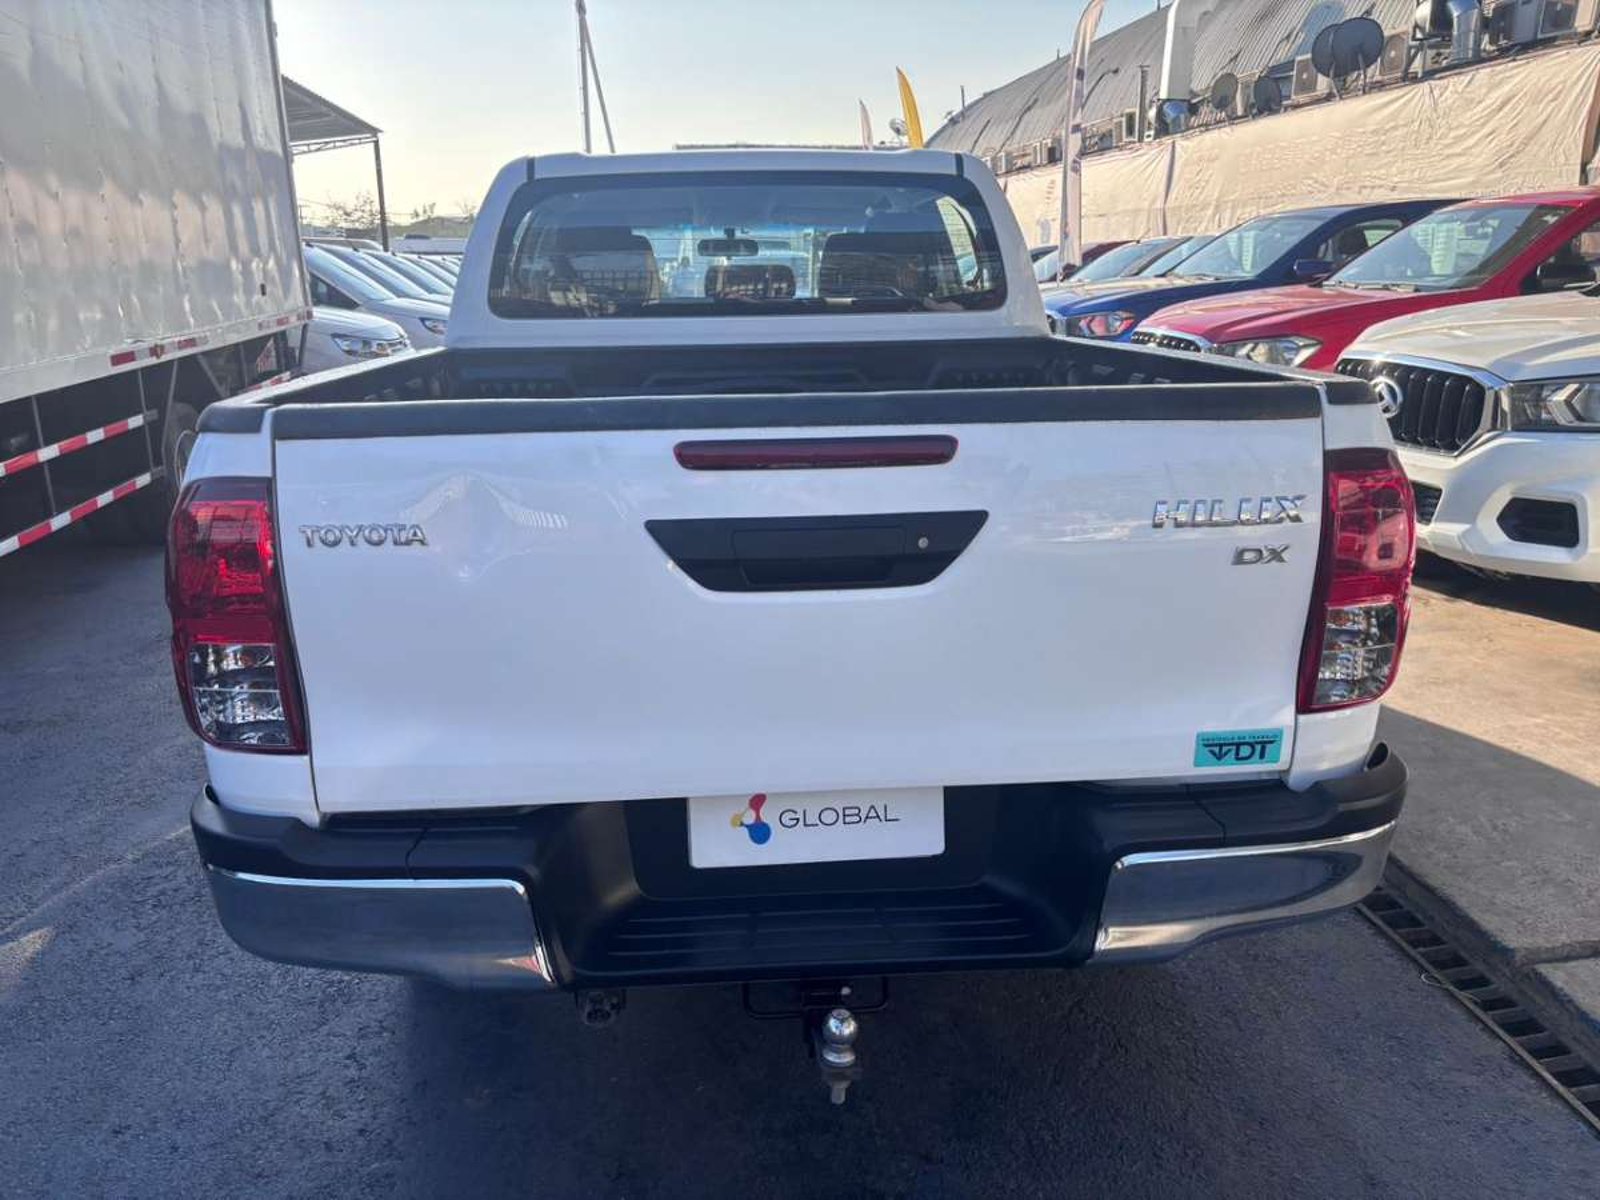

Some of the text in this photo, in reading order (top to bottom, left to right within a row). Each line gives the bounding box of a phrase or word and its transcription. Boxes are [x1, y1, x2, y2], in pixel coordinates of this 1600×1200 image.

[1152, 494, 1306, 528] HILUX
[299, 523, 428, 548] TOYOTA
[1231, 544, 1290, 565] DX
[779, 804, 900, 828] GLOBAL
